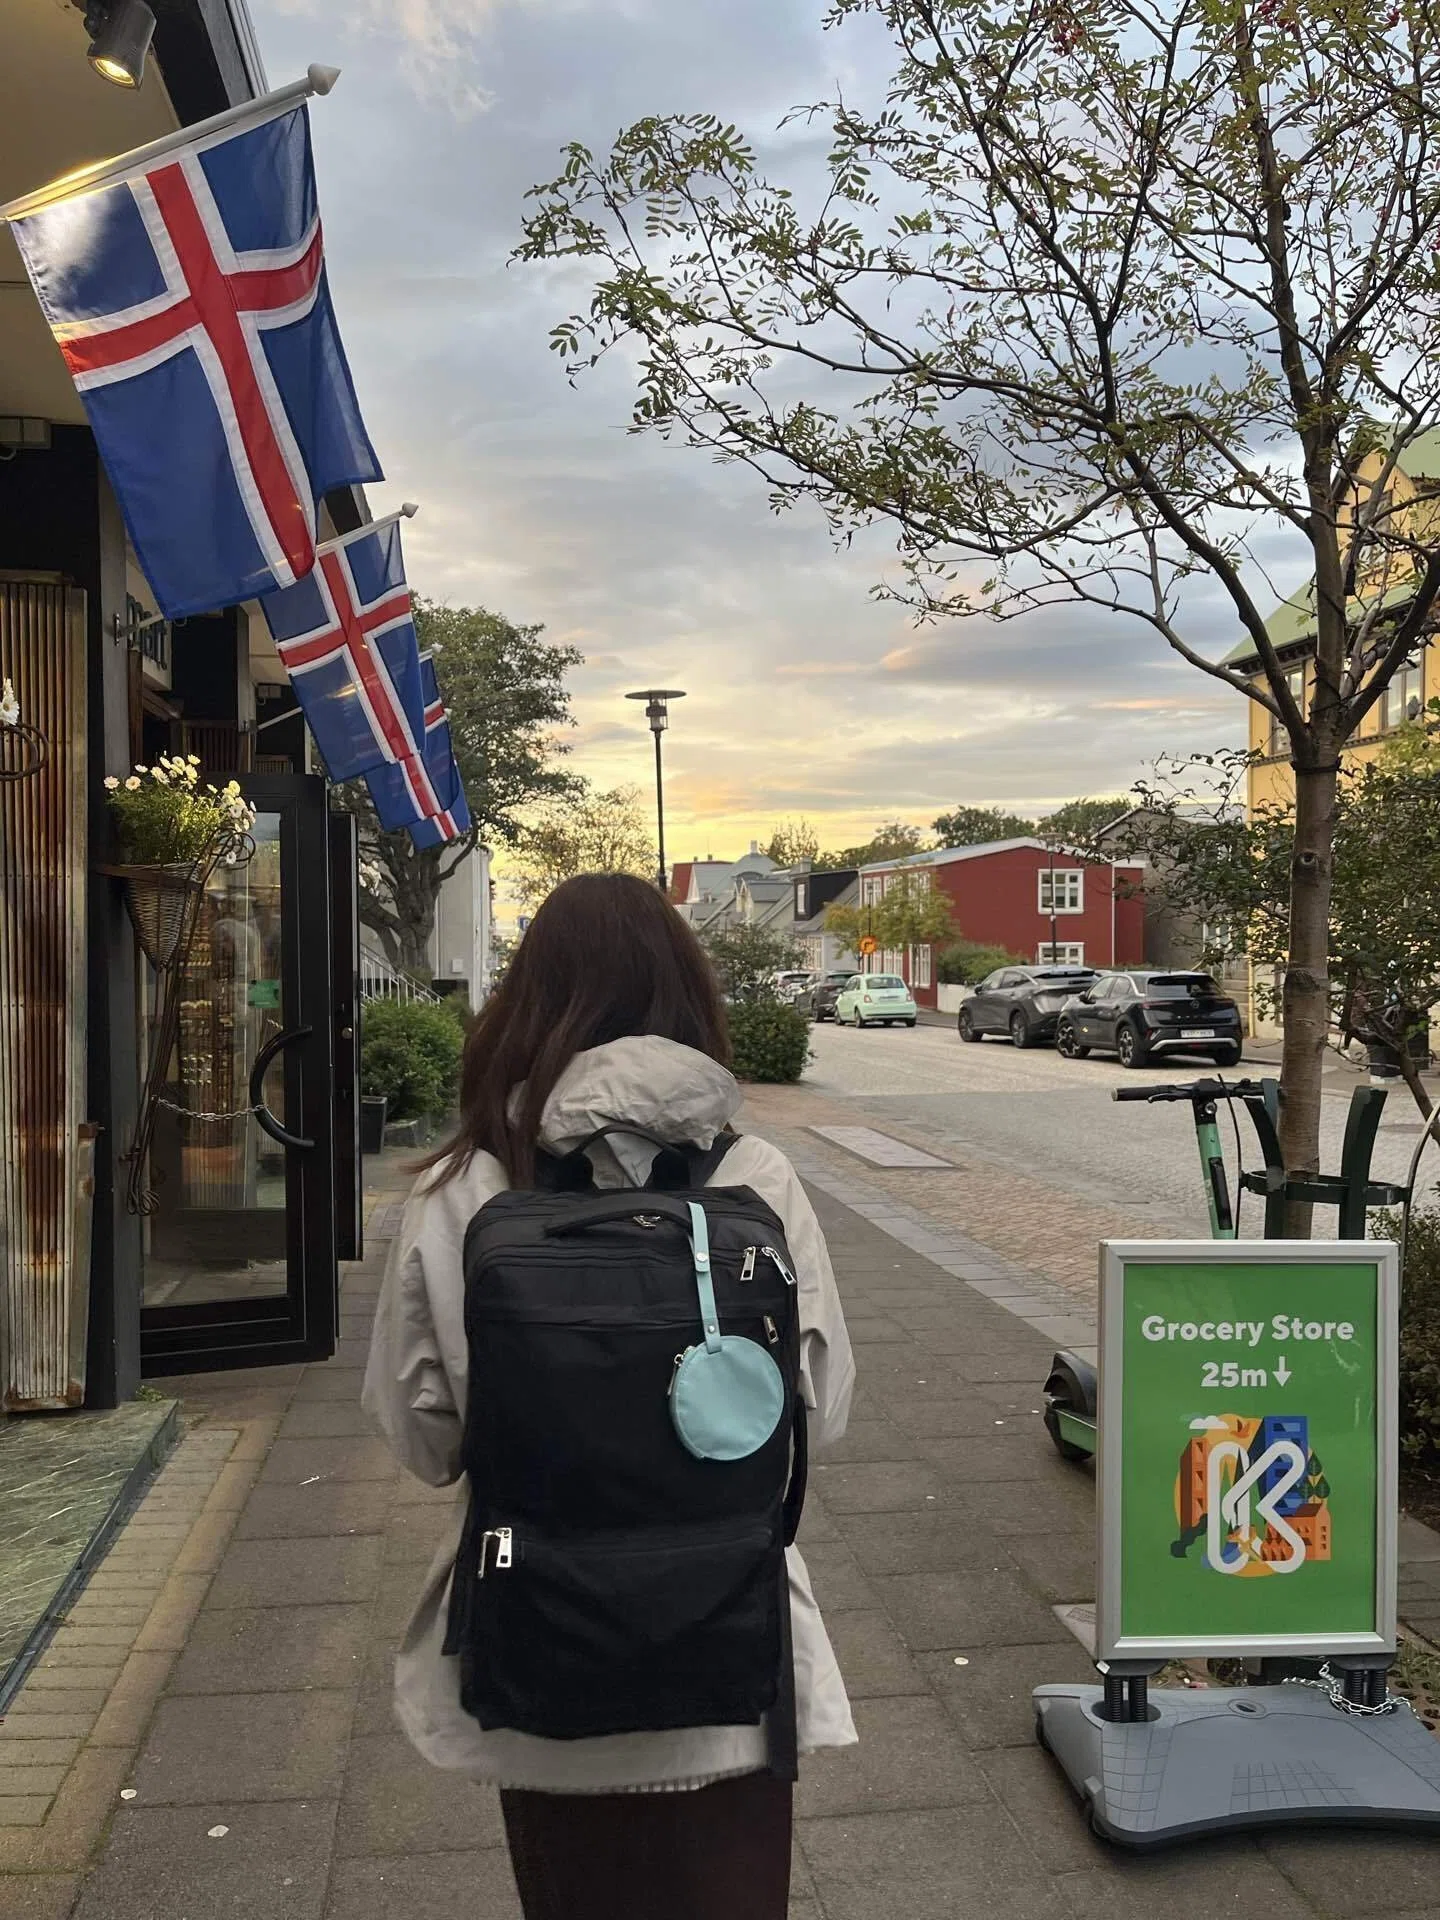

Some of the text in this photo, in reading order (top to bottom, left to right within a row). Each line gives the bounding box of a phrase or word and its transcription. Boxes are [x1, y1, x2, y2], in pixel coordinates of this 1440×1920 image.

[1141, 1314, 1355, 1347] Grocery Store
[1200, 1361, 1268, 1388] 25m
